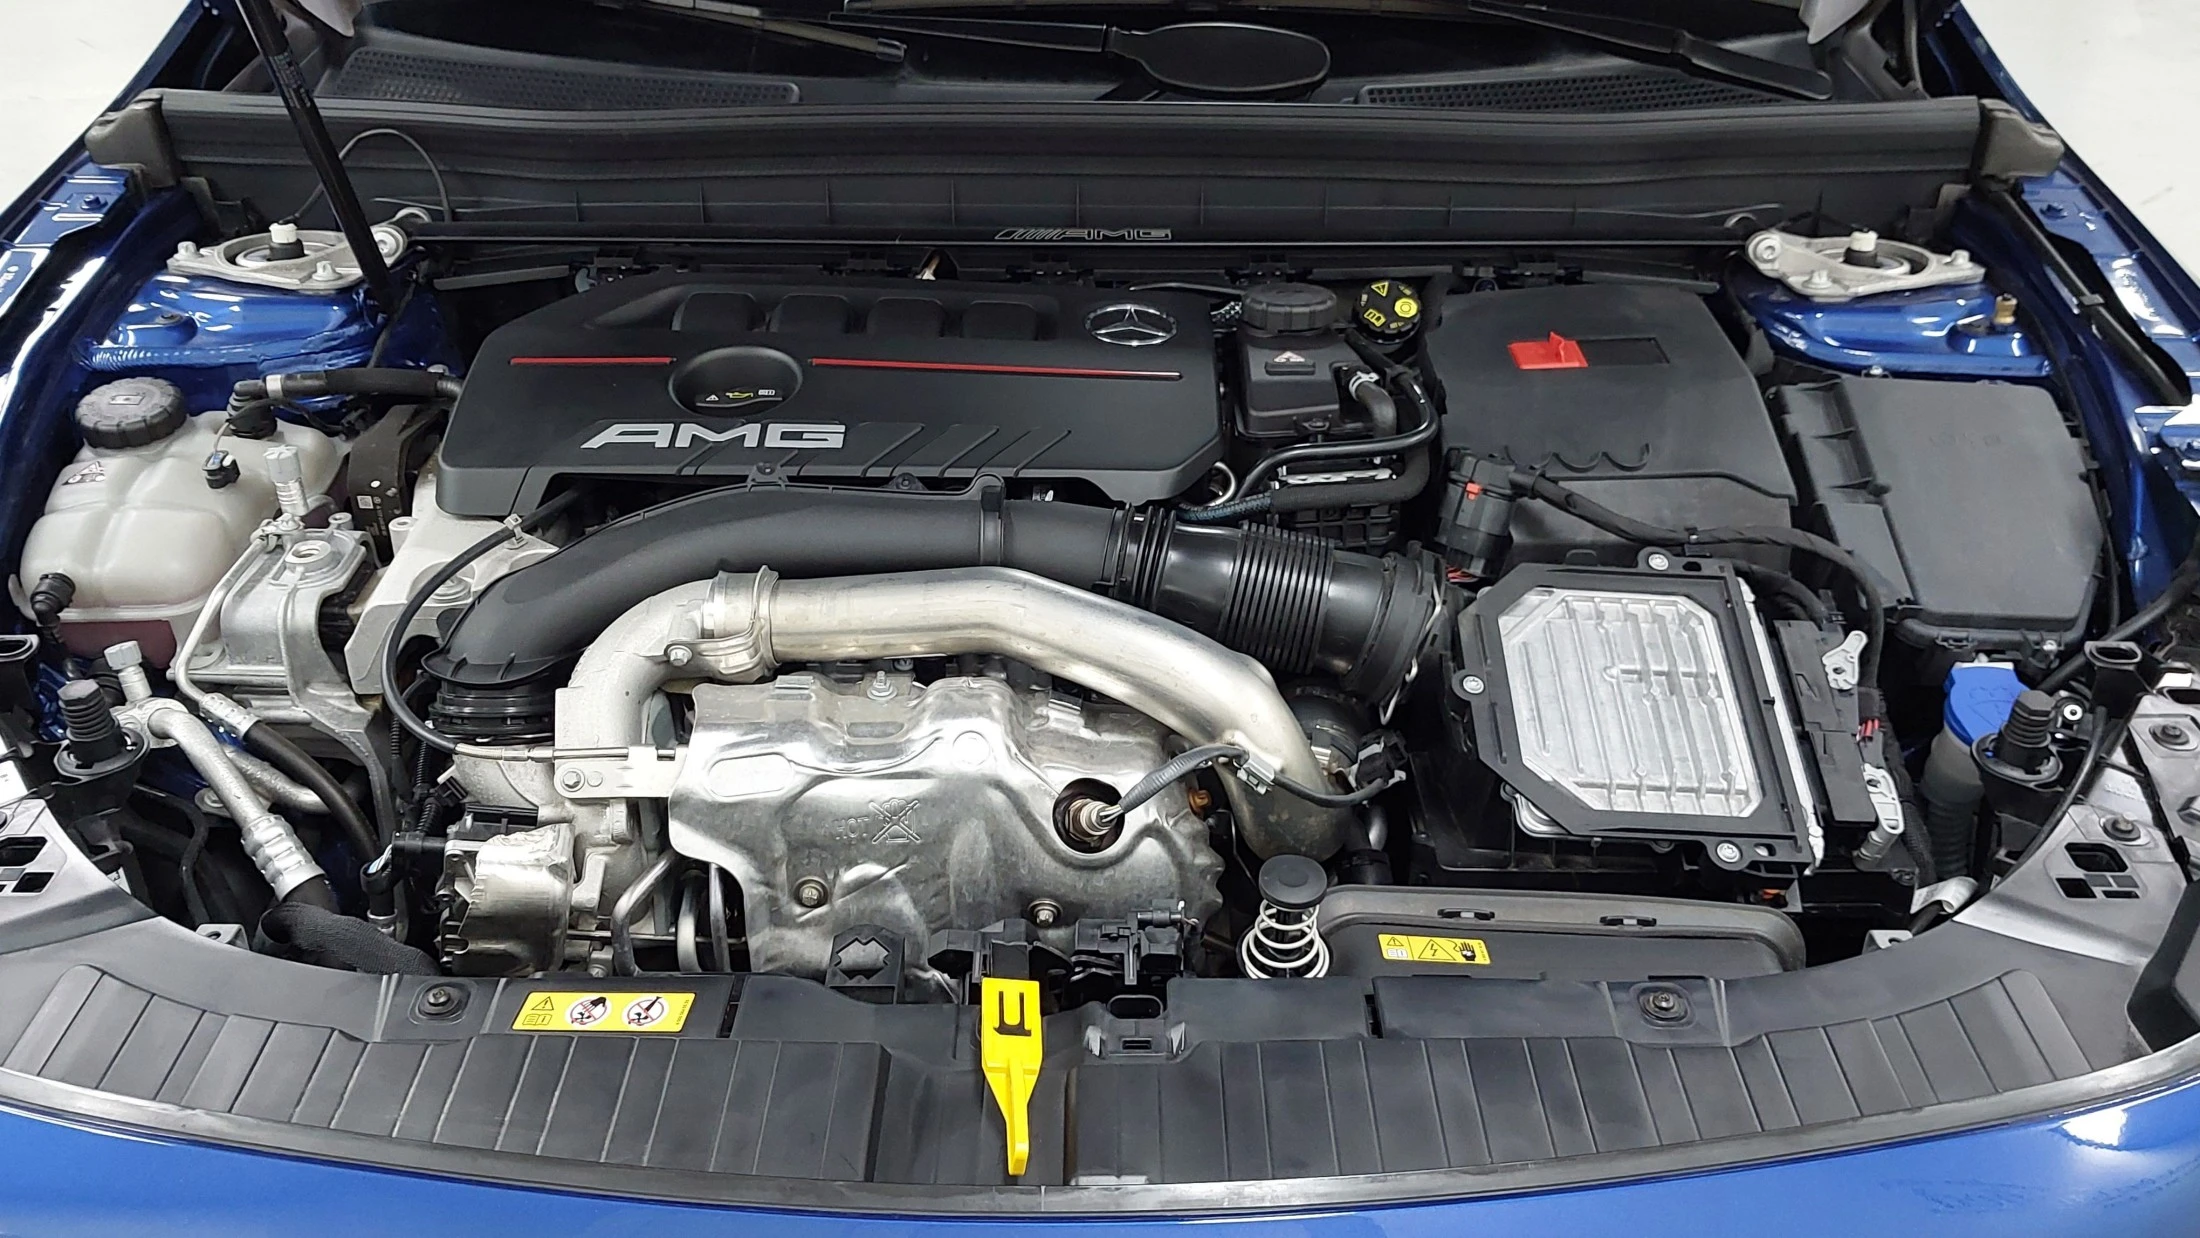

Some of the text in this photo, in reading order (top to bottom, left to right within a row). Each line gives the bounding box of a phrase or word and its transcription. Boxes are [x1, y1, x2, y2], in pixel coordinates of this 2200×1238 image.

[1052, 228, 1172, 241] AMG
[580, 423, 846, 449] AMG
[832, 816, 870, 840] HOT
